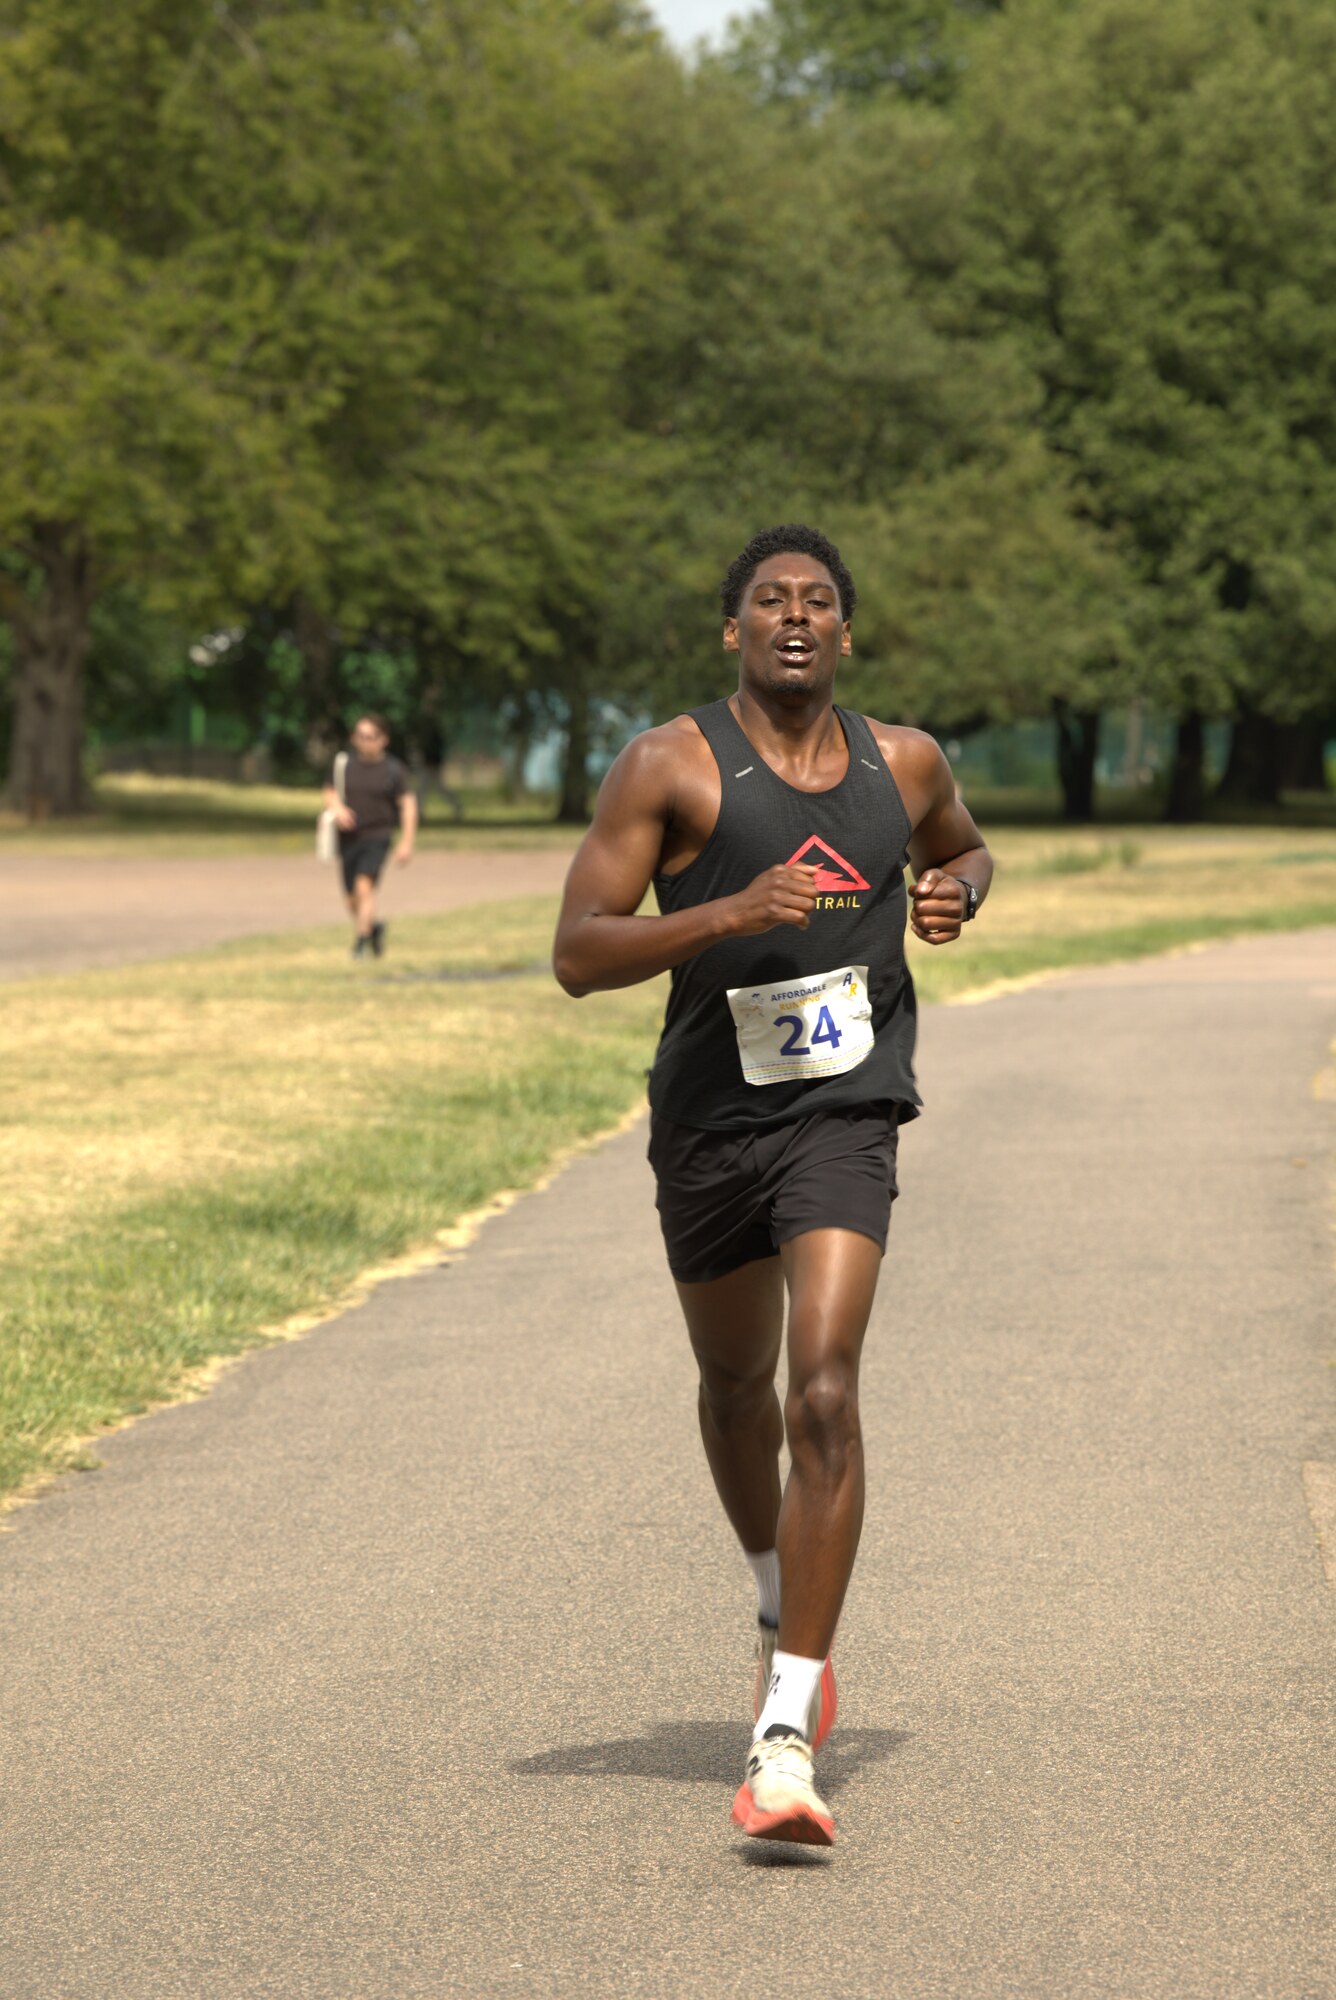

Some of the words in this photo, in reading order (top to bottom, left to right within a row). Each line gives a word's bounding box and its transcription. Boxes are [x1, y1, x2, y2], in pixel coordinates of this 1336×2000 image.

[770, 984, 827, 1002] AFFORDABLE
[779, 995, 820, 1012] RUNNING
[773, 1005, 842, 1056] 24
